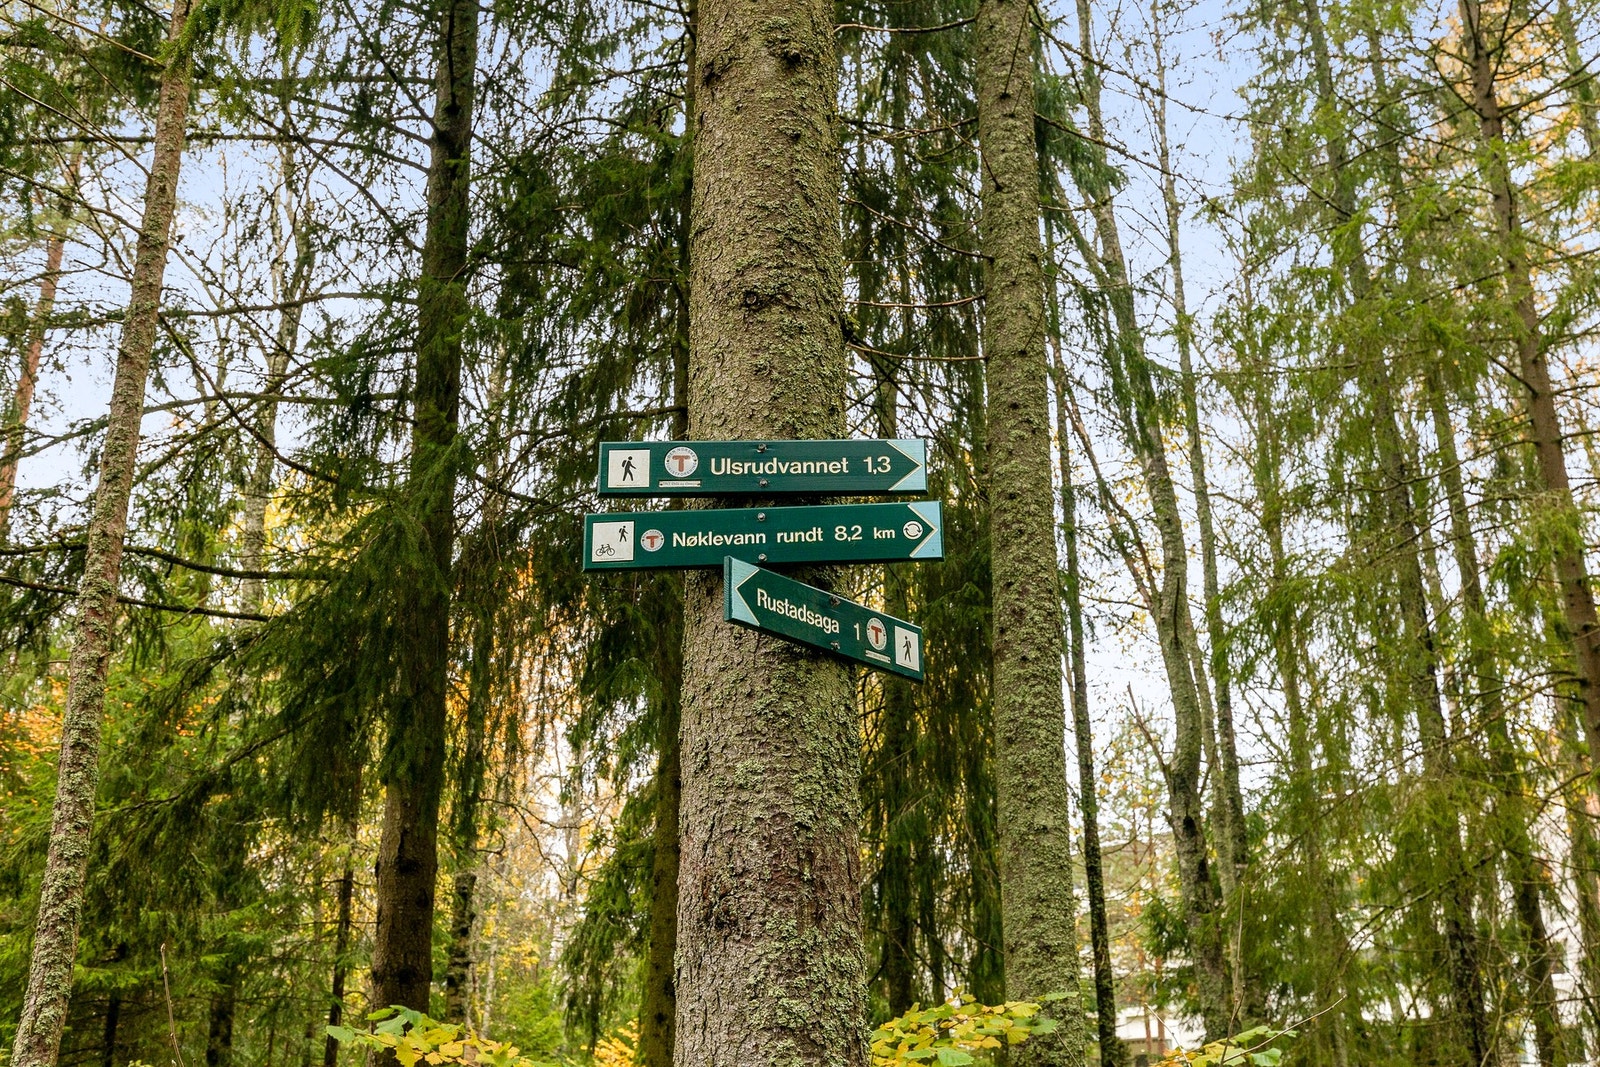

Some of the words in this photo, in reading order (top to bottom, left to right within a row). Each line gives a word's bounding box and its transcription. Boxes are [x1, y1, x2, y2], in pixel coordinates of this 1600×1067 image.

[672, 455, 691, 472] T
[710, 457, 849, 475] Ulsrudvannet
[863, 456, 891, 475] 1,3
[646, 535, 659, 548] T
[672, 531, 766, 547] Nøklevann
[776, 527, 824, 543] rundt
[834, 525, 863, 542] 8,2
[873, 527, 896, 539] km
[757, 588, 840, 634] Rustadsaga
[853, 622, 860, 640] 1
[870, 625, 882, 645] T
